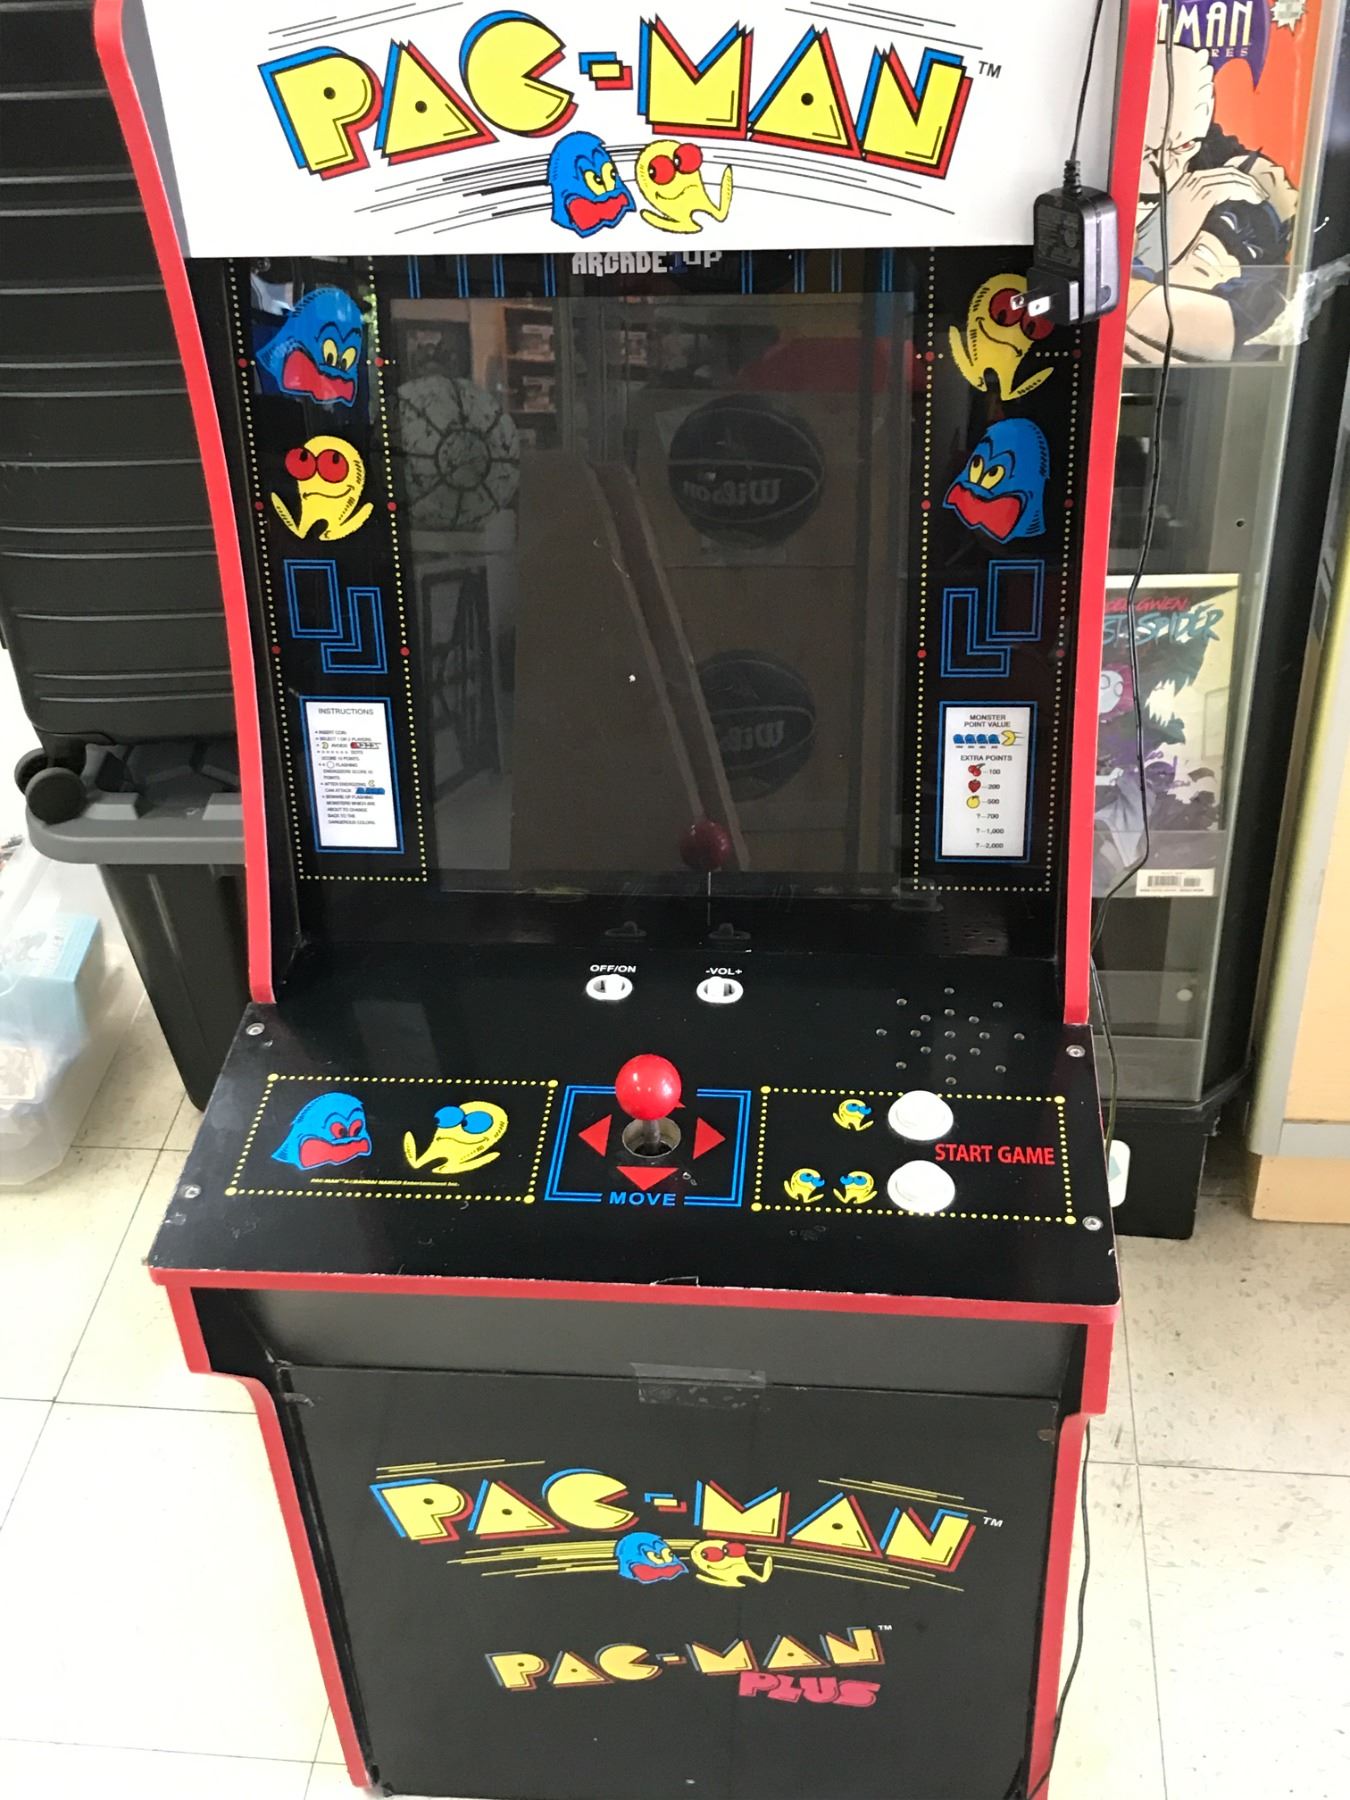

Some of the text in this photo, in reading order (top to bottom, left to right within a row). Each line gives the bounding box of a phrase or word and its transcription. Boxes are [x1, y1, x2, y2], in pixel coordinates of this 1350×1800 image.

[258, 8, 972, 180] PAC-MAN
[318, 708, 374, 716] INSTRUCTIONS
[589, 964, 637, 973] OFF/ON
[934, 1143, 1056, 1165] START GAME
[609, 1191, 677, 1206] MOVE
[370, 1468, 977, 1572] PAC-MAN
[485, 1627, 885, 1691] PAC-MAN
[739, 1671, 880, 1707] PLUS
